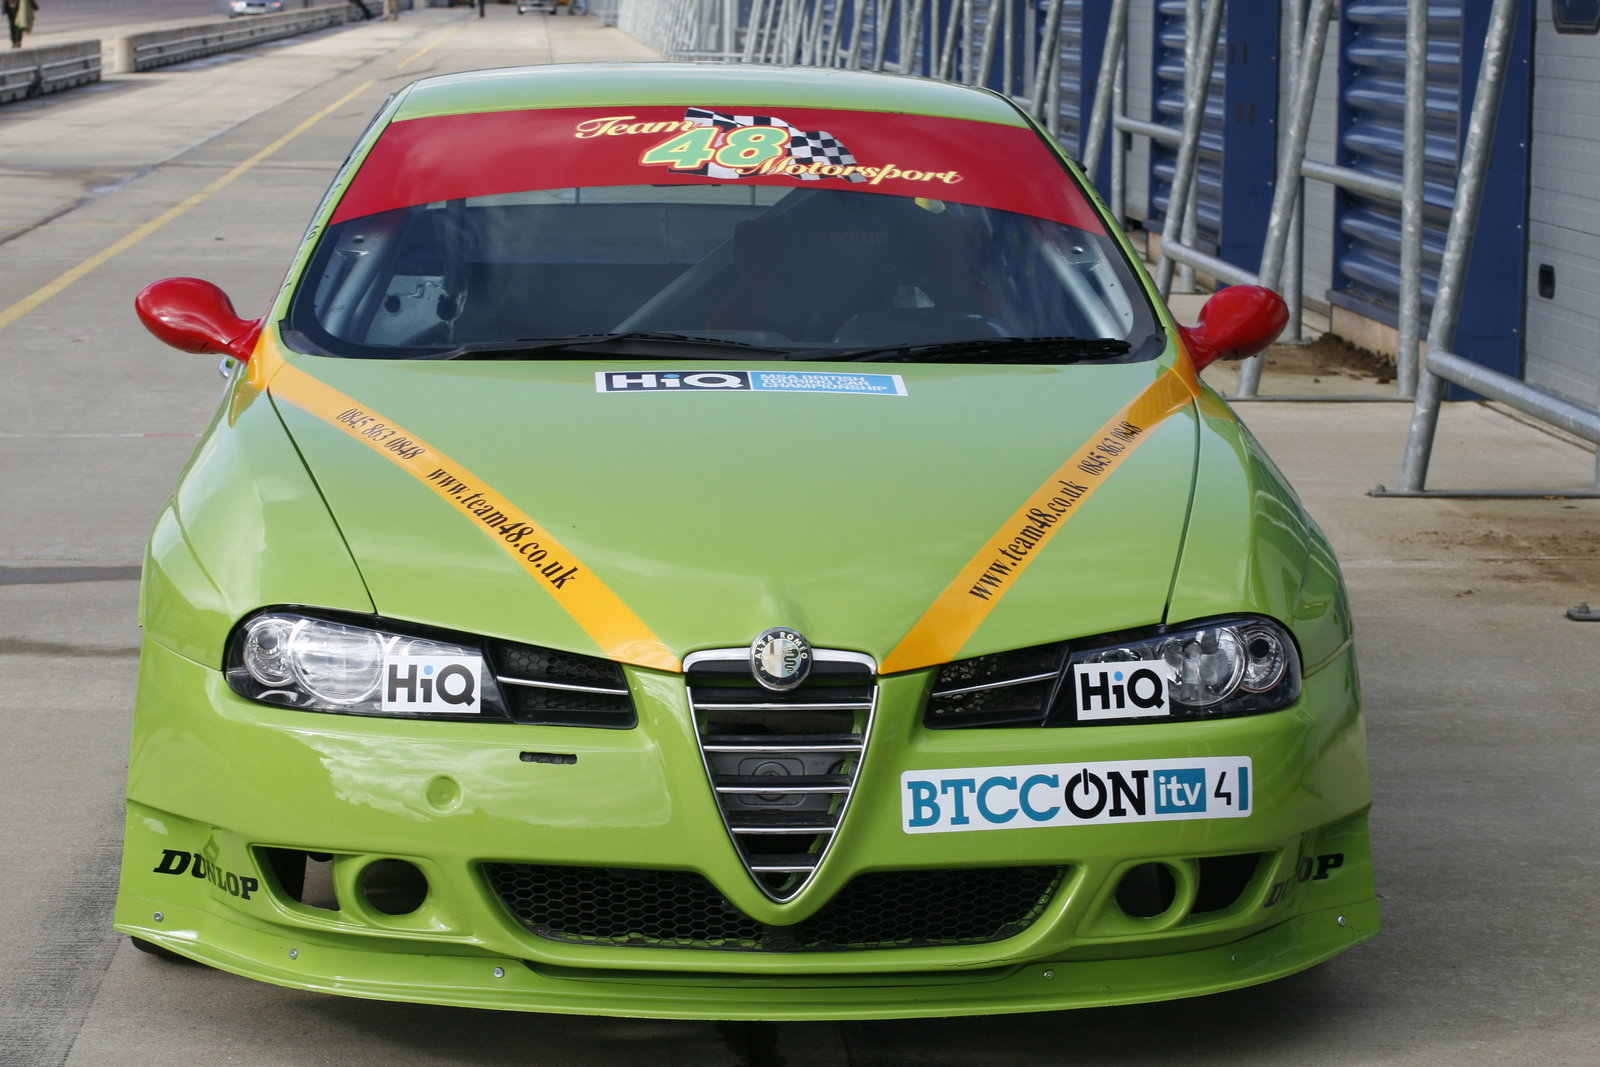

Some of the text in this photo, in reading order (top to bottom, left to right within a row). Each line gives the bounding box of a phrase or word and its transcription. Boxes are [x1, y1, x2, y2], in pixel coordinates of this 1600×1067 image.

[574, 115, 964, 185] Team 48 Motorsport
[612, 373, 744, 389] HiQ
[761, 383, 888, 391] CHAMPIONSHIP
[336, 408, 426, 460] 0845 863 0848
[1077, 451, 1112, 476] 0845
[1096, 437, 1126, 456] 863
[426, 468, 579, 590] www.team48.co.uk
[969, 480, 1089, 601] www.team48.co.uk
[755, 631, 808, 660] ALFA ROMEO
[387, 664, 476, 707] HiQ
[1080, 668, 1165, 711] HiQ
[153, 849, 259, 900] DUNLOP
[1263, 853, 1345, 908] DOP
